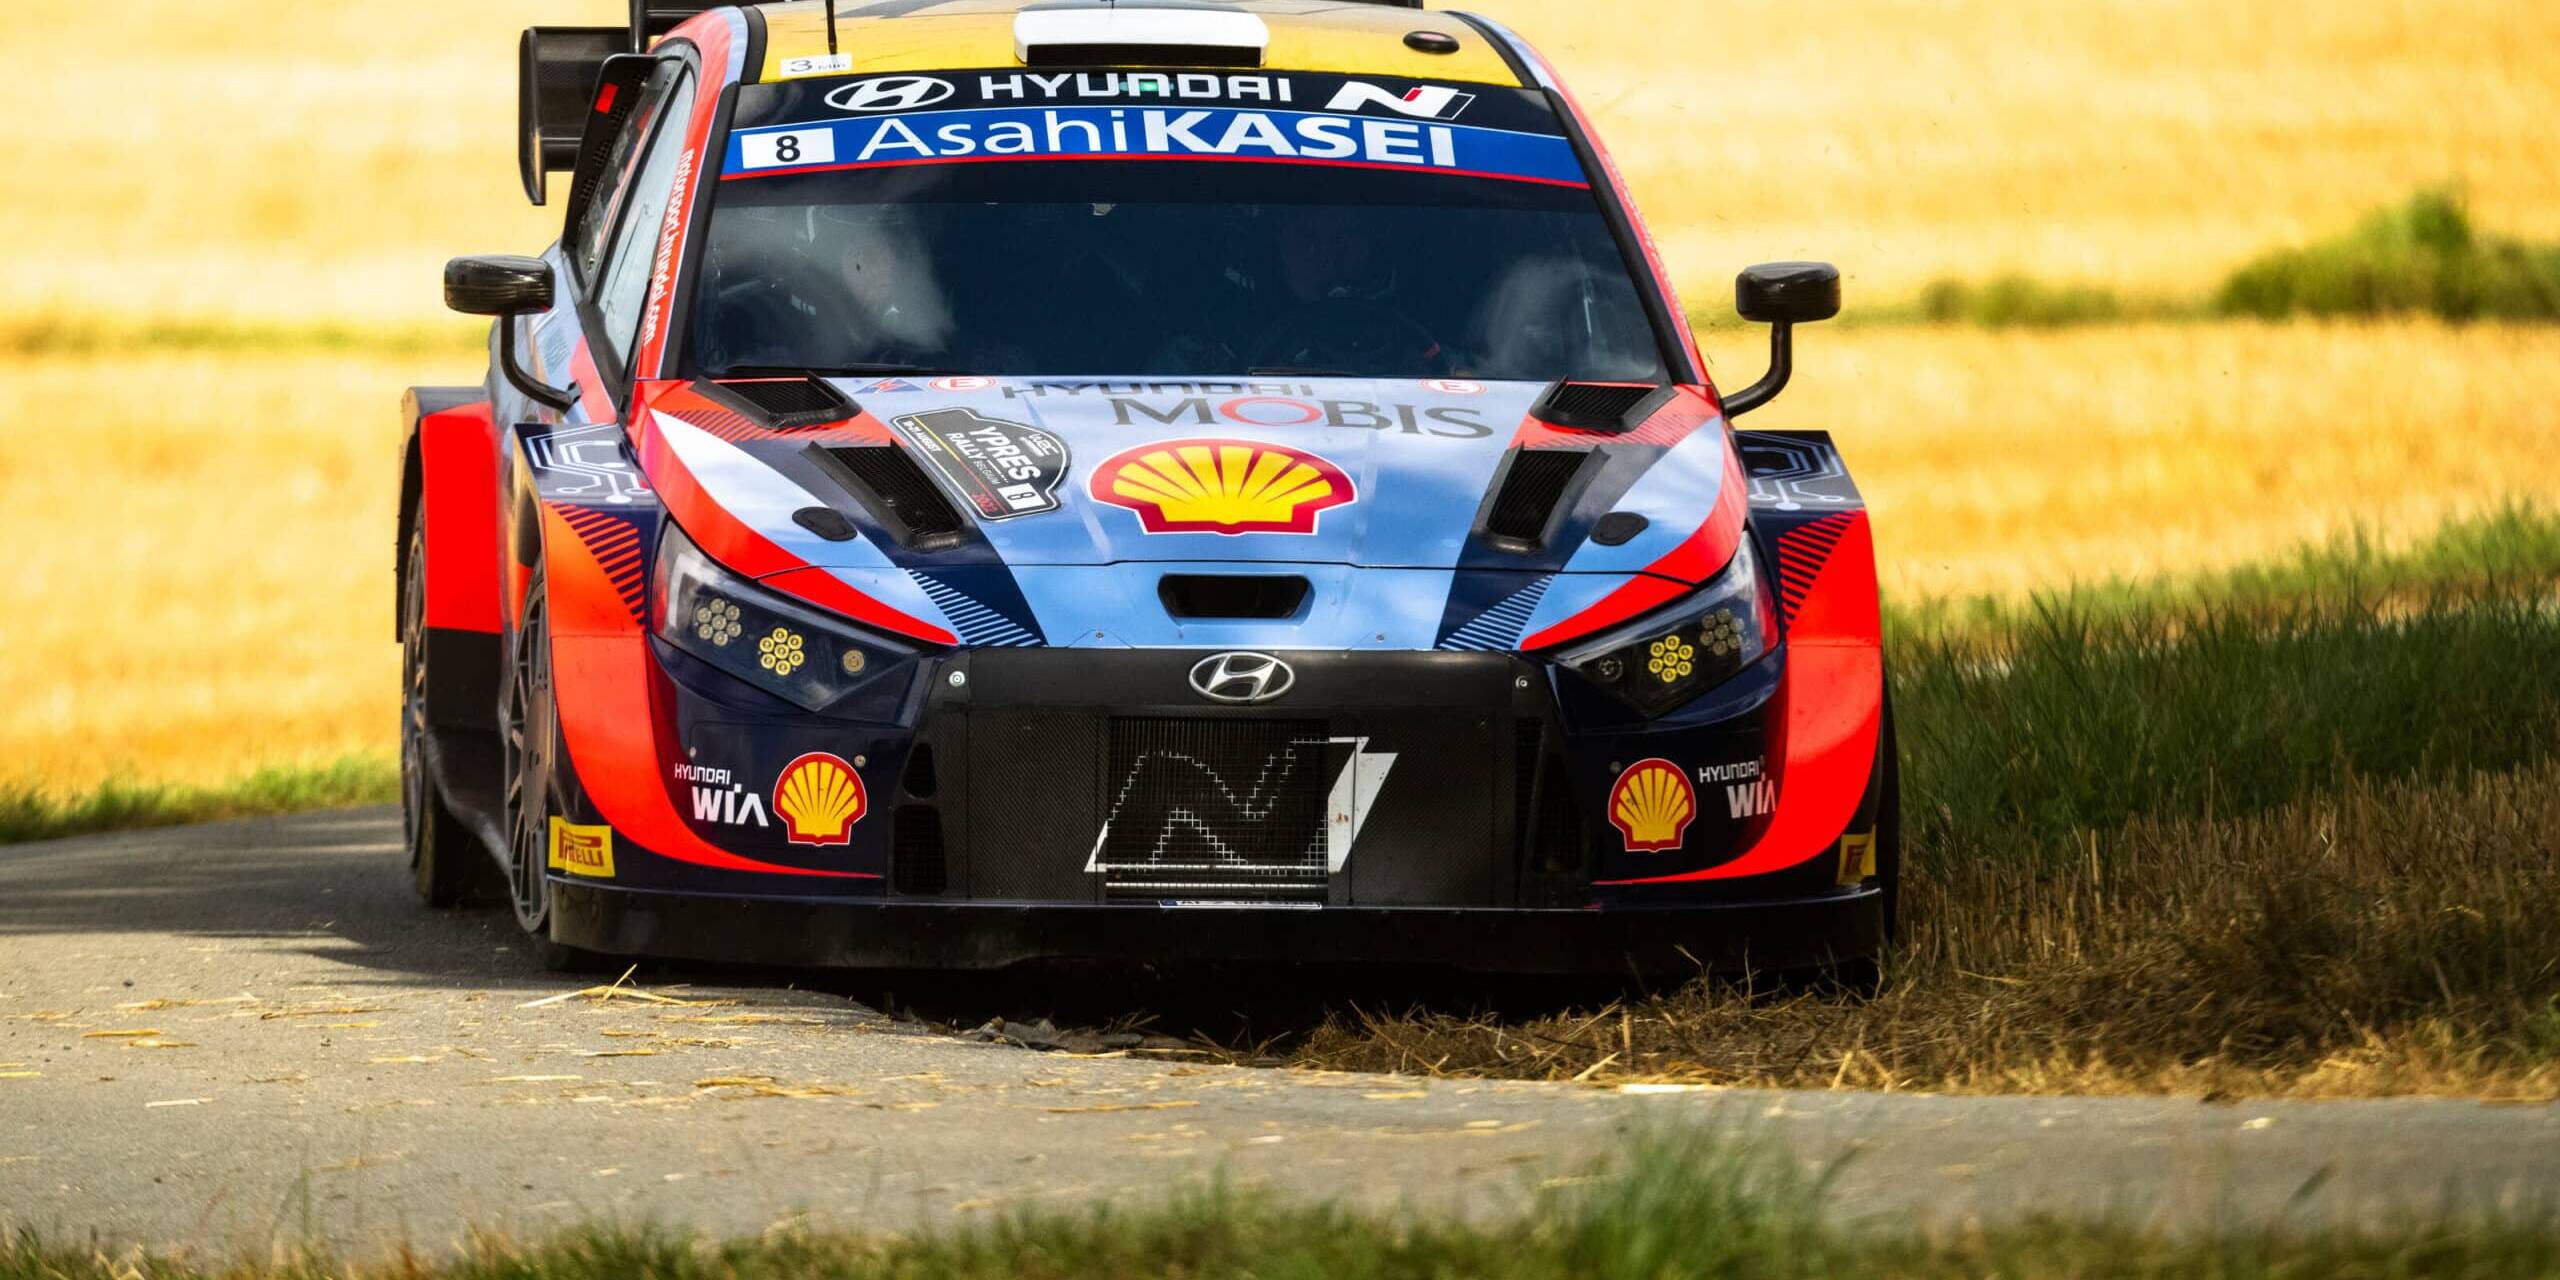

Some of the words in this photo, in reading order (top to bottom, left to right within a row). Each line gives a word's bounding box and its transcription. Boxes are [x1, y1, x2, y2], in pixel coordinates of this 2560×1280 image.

[979, 73, 1292, 101] HYUNDAI
[775, 135, 801, 162] 8
[857, 109, 1127, 161] Asahi
[1142, 110, 1456, 167] KASEI
[1002, 383, 1314, 399] HYUNDAI
[1109, 397, 1494, 438] MOBIS
[945, 432, 988, 460] RALLY
[969, 426, 1041, 481] YPRES
[1007, 492, 1035, 500] 8
[674, 763, 731, 785] HYUNDAI
[1699, 760, 1760, 783] HYUNDAI
